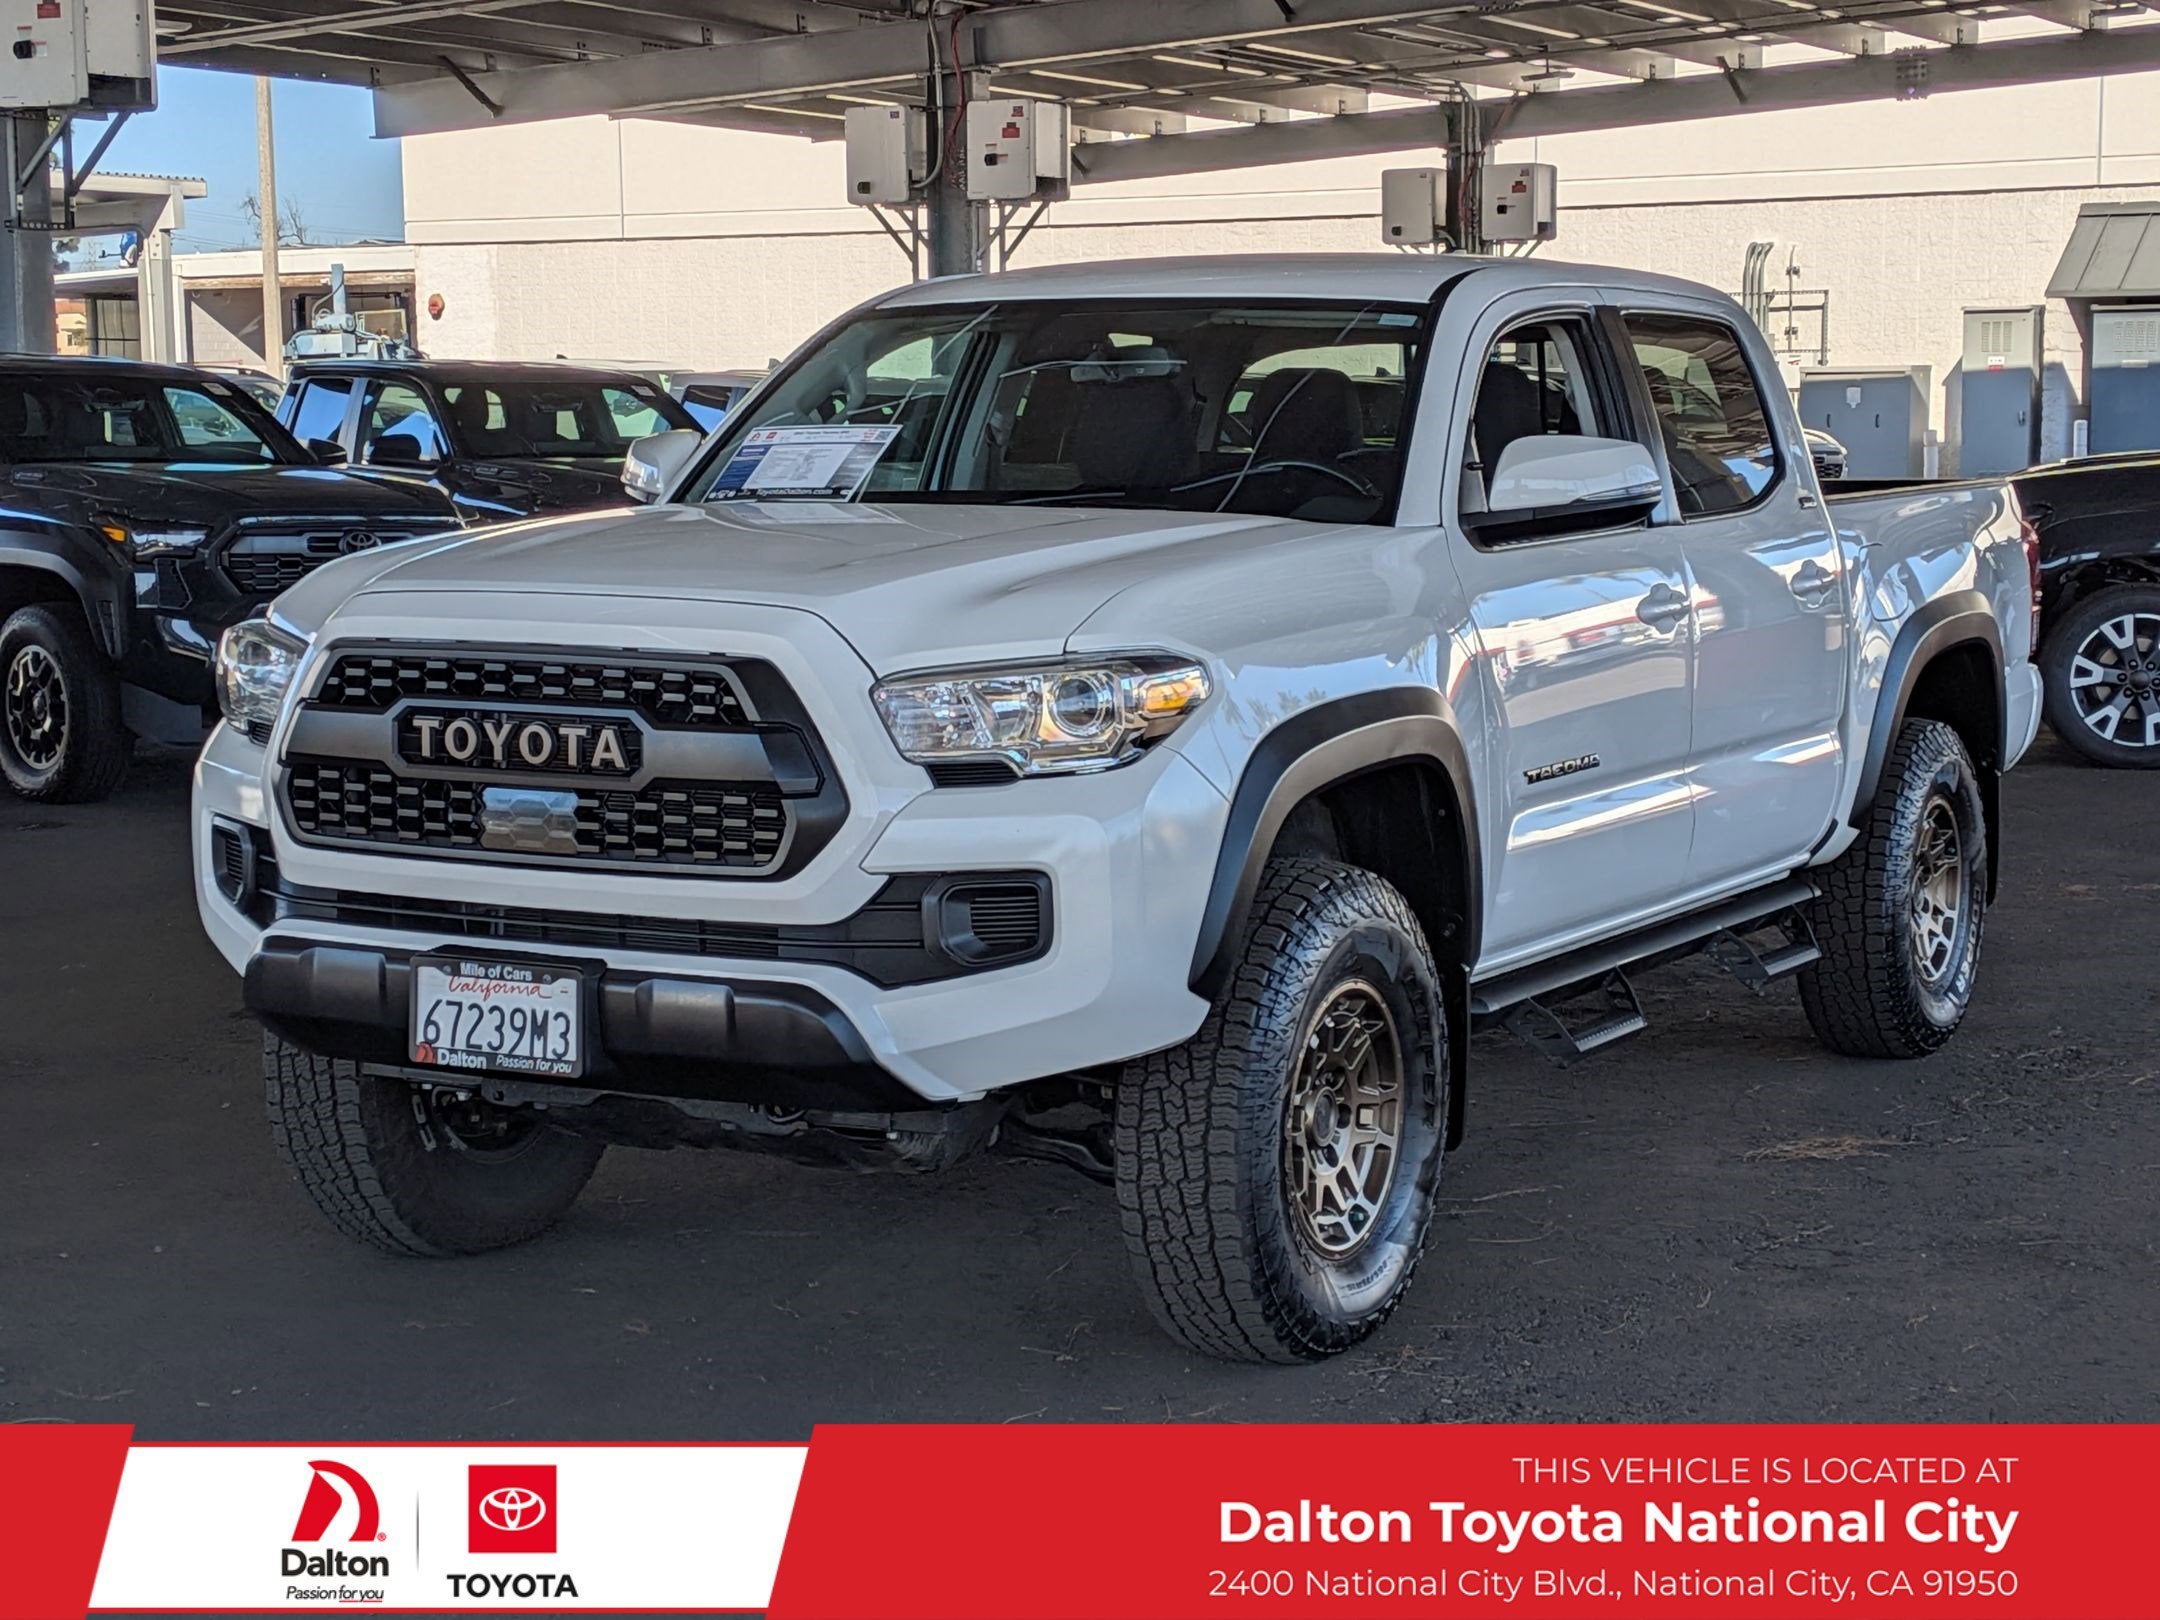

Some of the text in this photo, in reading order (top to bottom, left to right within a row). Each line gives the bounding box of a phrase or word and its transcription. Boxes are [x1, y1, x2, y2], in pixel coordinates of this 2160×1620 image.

[412, 716, 629, 770] TOYOTA
[1523, 753, 1600, 784] TACOMA
[1955, 884, 1981, 993] COOPER
[460, 962, 533, 982] Mile of Cars
[448, 975, 552, 1001] California
[423, 999, 571, 1059] 67239M3
[437, 1049, 573, 1074] Dalton Passion for you
